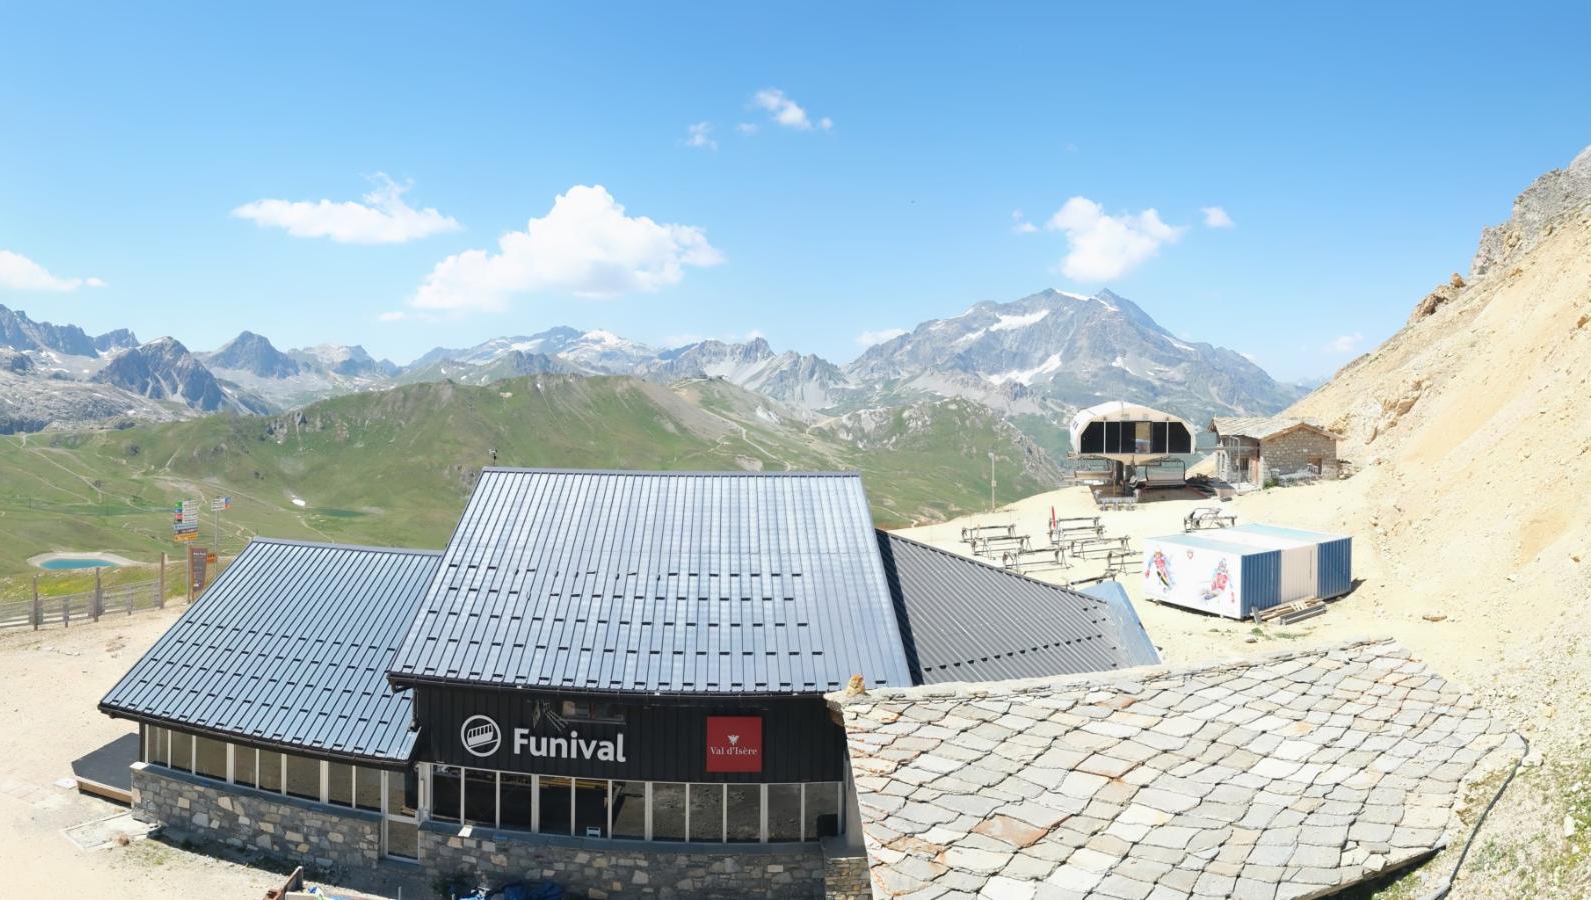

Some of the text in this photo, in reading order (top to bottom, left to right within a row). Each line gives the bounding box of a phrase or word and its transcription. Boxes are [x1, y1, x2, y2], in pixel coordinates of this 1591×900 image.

[514, 728, 626, 763] Funival
[710, 745, 758, 756] Val d'Isère
